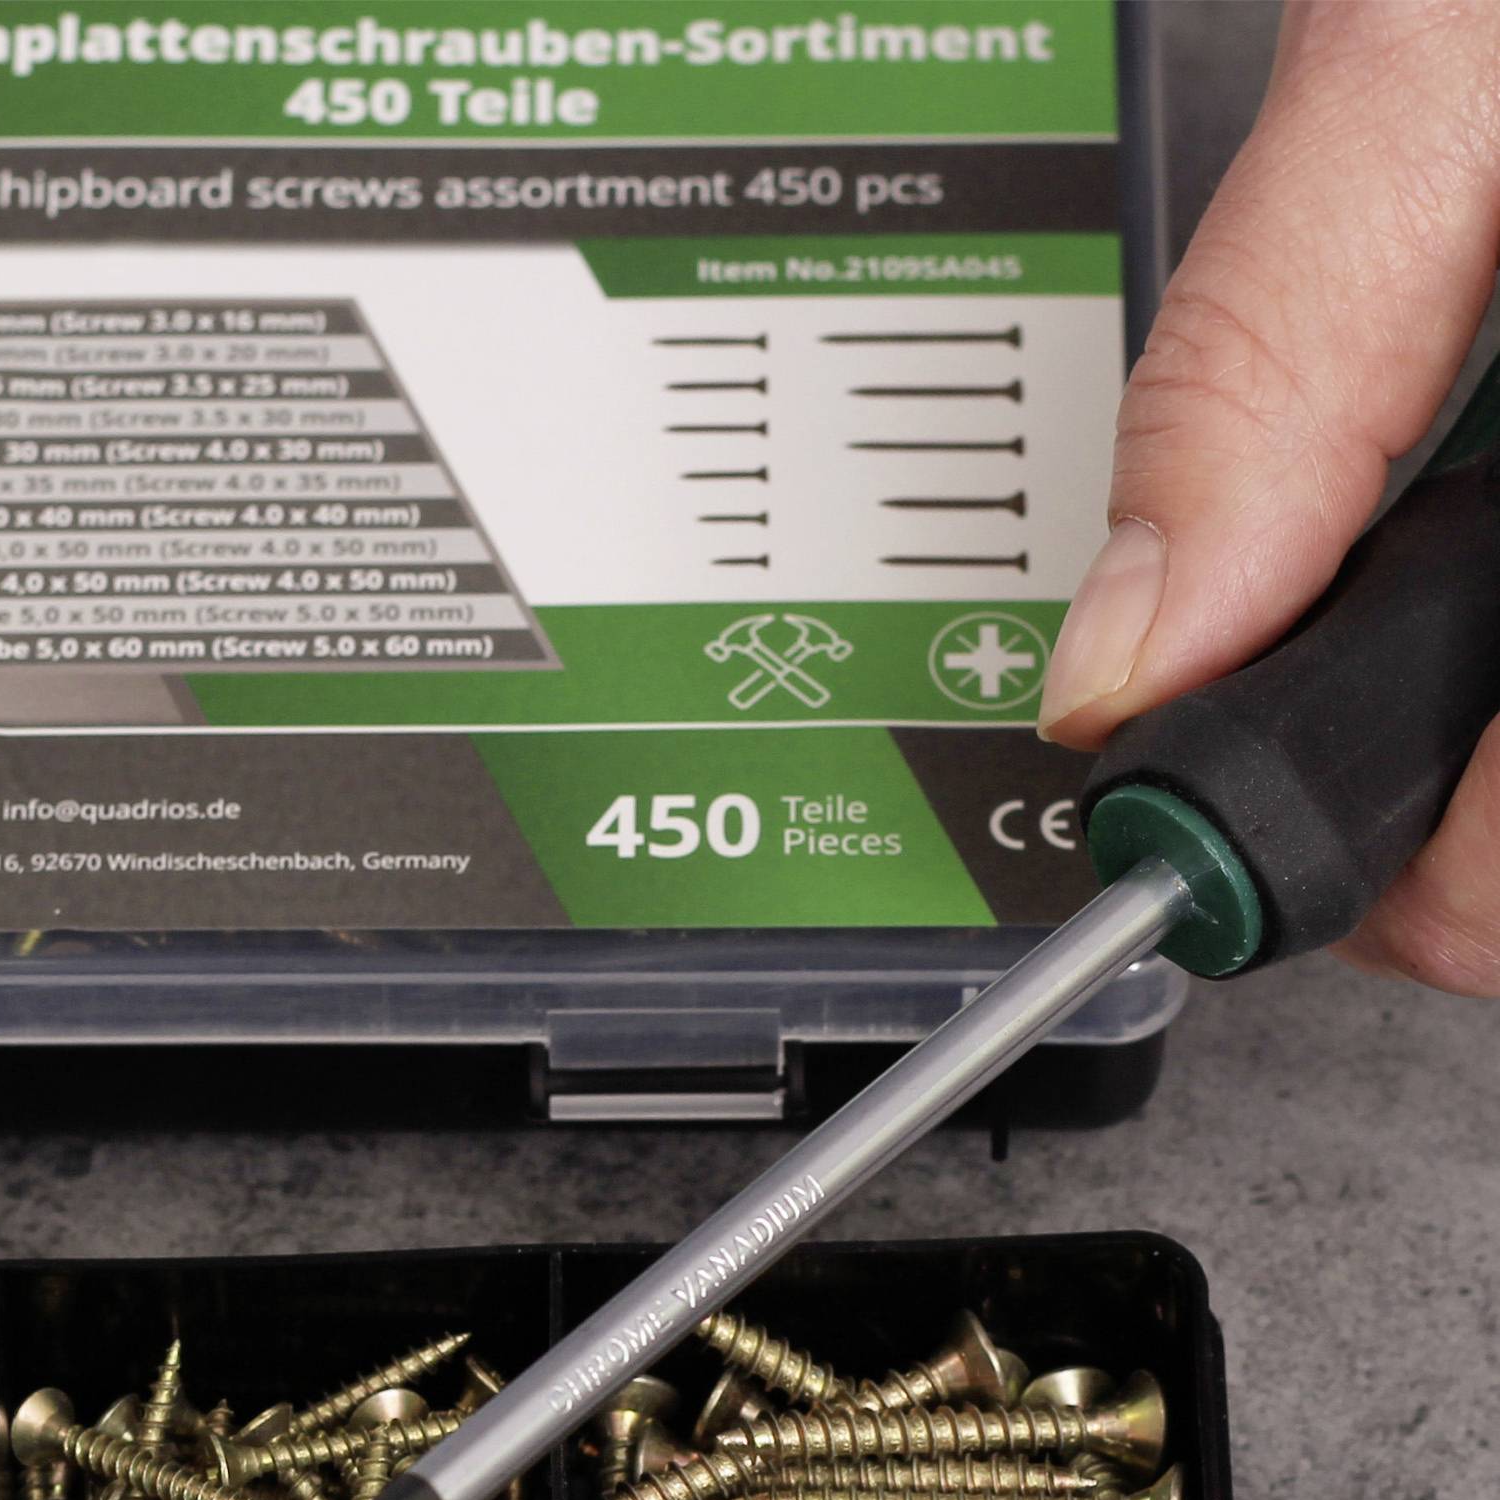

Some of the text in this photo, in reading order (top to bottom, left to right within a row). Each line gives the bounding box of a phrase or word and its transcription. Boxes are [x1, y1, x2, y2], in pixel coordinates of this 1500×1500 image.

[283, 77, 601, 127] 450 Teile
[245, 175, 423, 211] screws
[434, 170, 734, 210] assortment
[742, 167, 842, 206] 450
[855, 172, 944, 215] pcs
[697, 258, 778, 283] Item
[14, 511, 32, 527] x
[37, 506, 73, 526] 40
[78, 510, 135, 526] mm
[139, 506, 236, 528] (Screw
[289, 508, 306, 524] x
[312, 504, 348, 524] 40
[352, 506, 420, 526] mm)
[33, 545, 48, 558] x
[57, 540, 89, 558] 50
[96, 543, 151, 558] mm
[158, 540, 252, 560] (Screw
[308, 543, 324, 557] x
[331, 538, 365, 556] 50
[371, 538, 438, 558] mm)
[49, 576, 67, 592] x
[73, 572, 108, 592] 50
[112, 575, 170, 592] mm
[175, 571, 271, 594] (Screw
[325, 574, 342, 589] x
[349, 569, 384, 589] 50
[389, 571, 456, 591] mm)
[68, 610, 83, 624] x
[91, 605, 124, 623] 50
[131, 609, 187, 623] mm
[194, 605, 289, 625] (Screw
[344, 608, 360, 621] x
[368, 603, 401, 621] 50
[408, 603, 474, 623] mm)
[84, 642, 102, 658] x
[107, 637, 143, 657] 60
[148, 641, 205, 657] mm
[211, 637, 307, 659] (Screw
[361, 640, 379, 656] x
[384, 635, 420, 655] 60
[426, 637, 493, 657] mm)
[2, 799, 241, 824] info@quadrios.de
[586, 794, 868, 858] 450 Teile
[783, 830, 902, 855] Pieces
[30, 853, 102, 873] 92670
[107, 852, 356, 873] Windischeschenbach,
[362, 851, 471, 875] Germany
